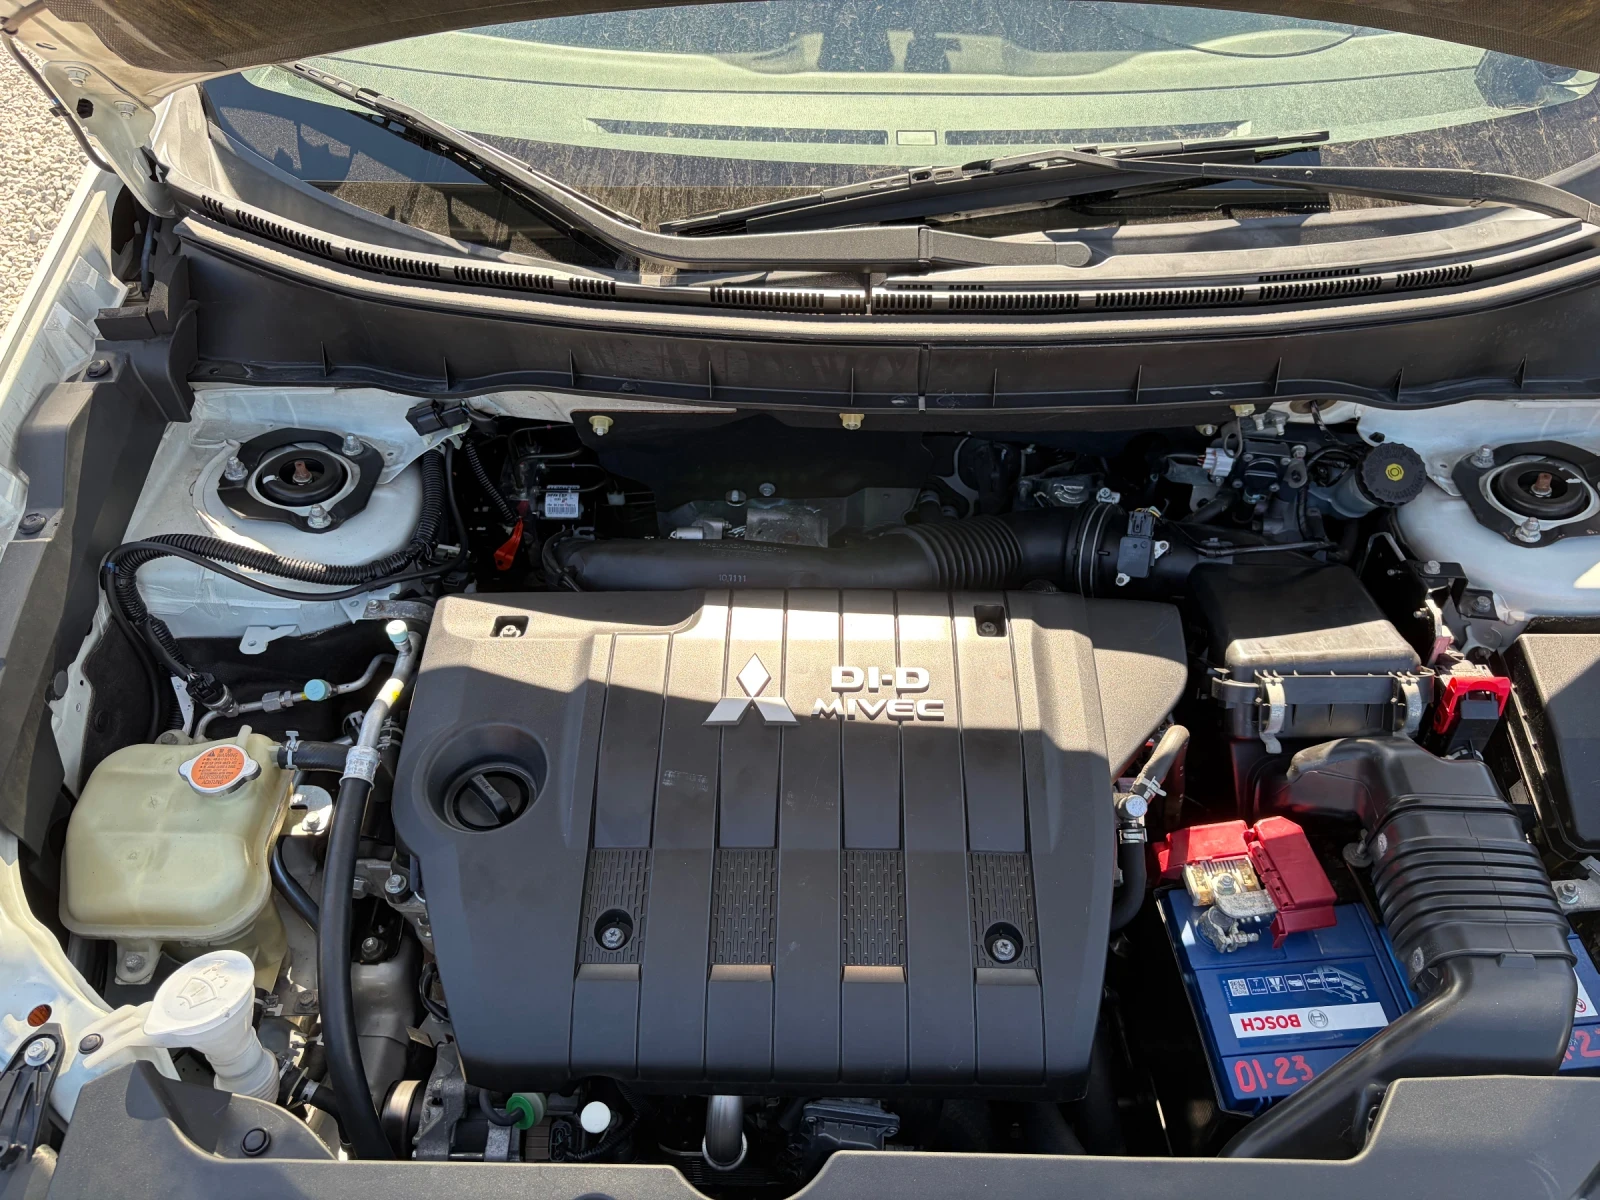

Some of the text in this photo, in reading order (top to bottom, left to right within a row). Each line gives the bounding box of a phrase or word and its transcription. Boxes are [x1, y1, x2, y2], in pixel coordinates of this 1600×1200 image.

[830, 665, 930, 693] DI-D
[810, 697, 945, 721] MIVEC
[1240, 1012, 1302, 1032] BOSCH
